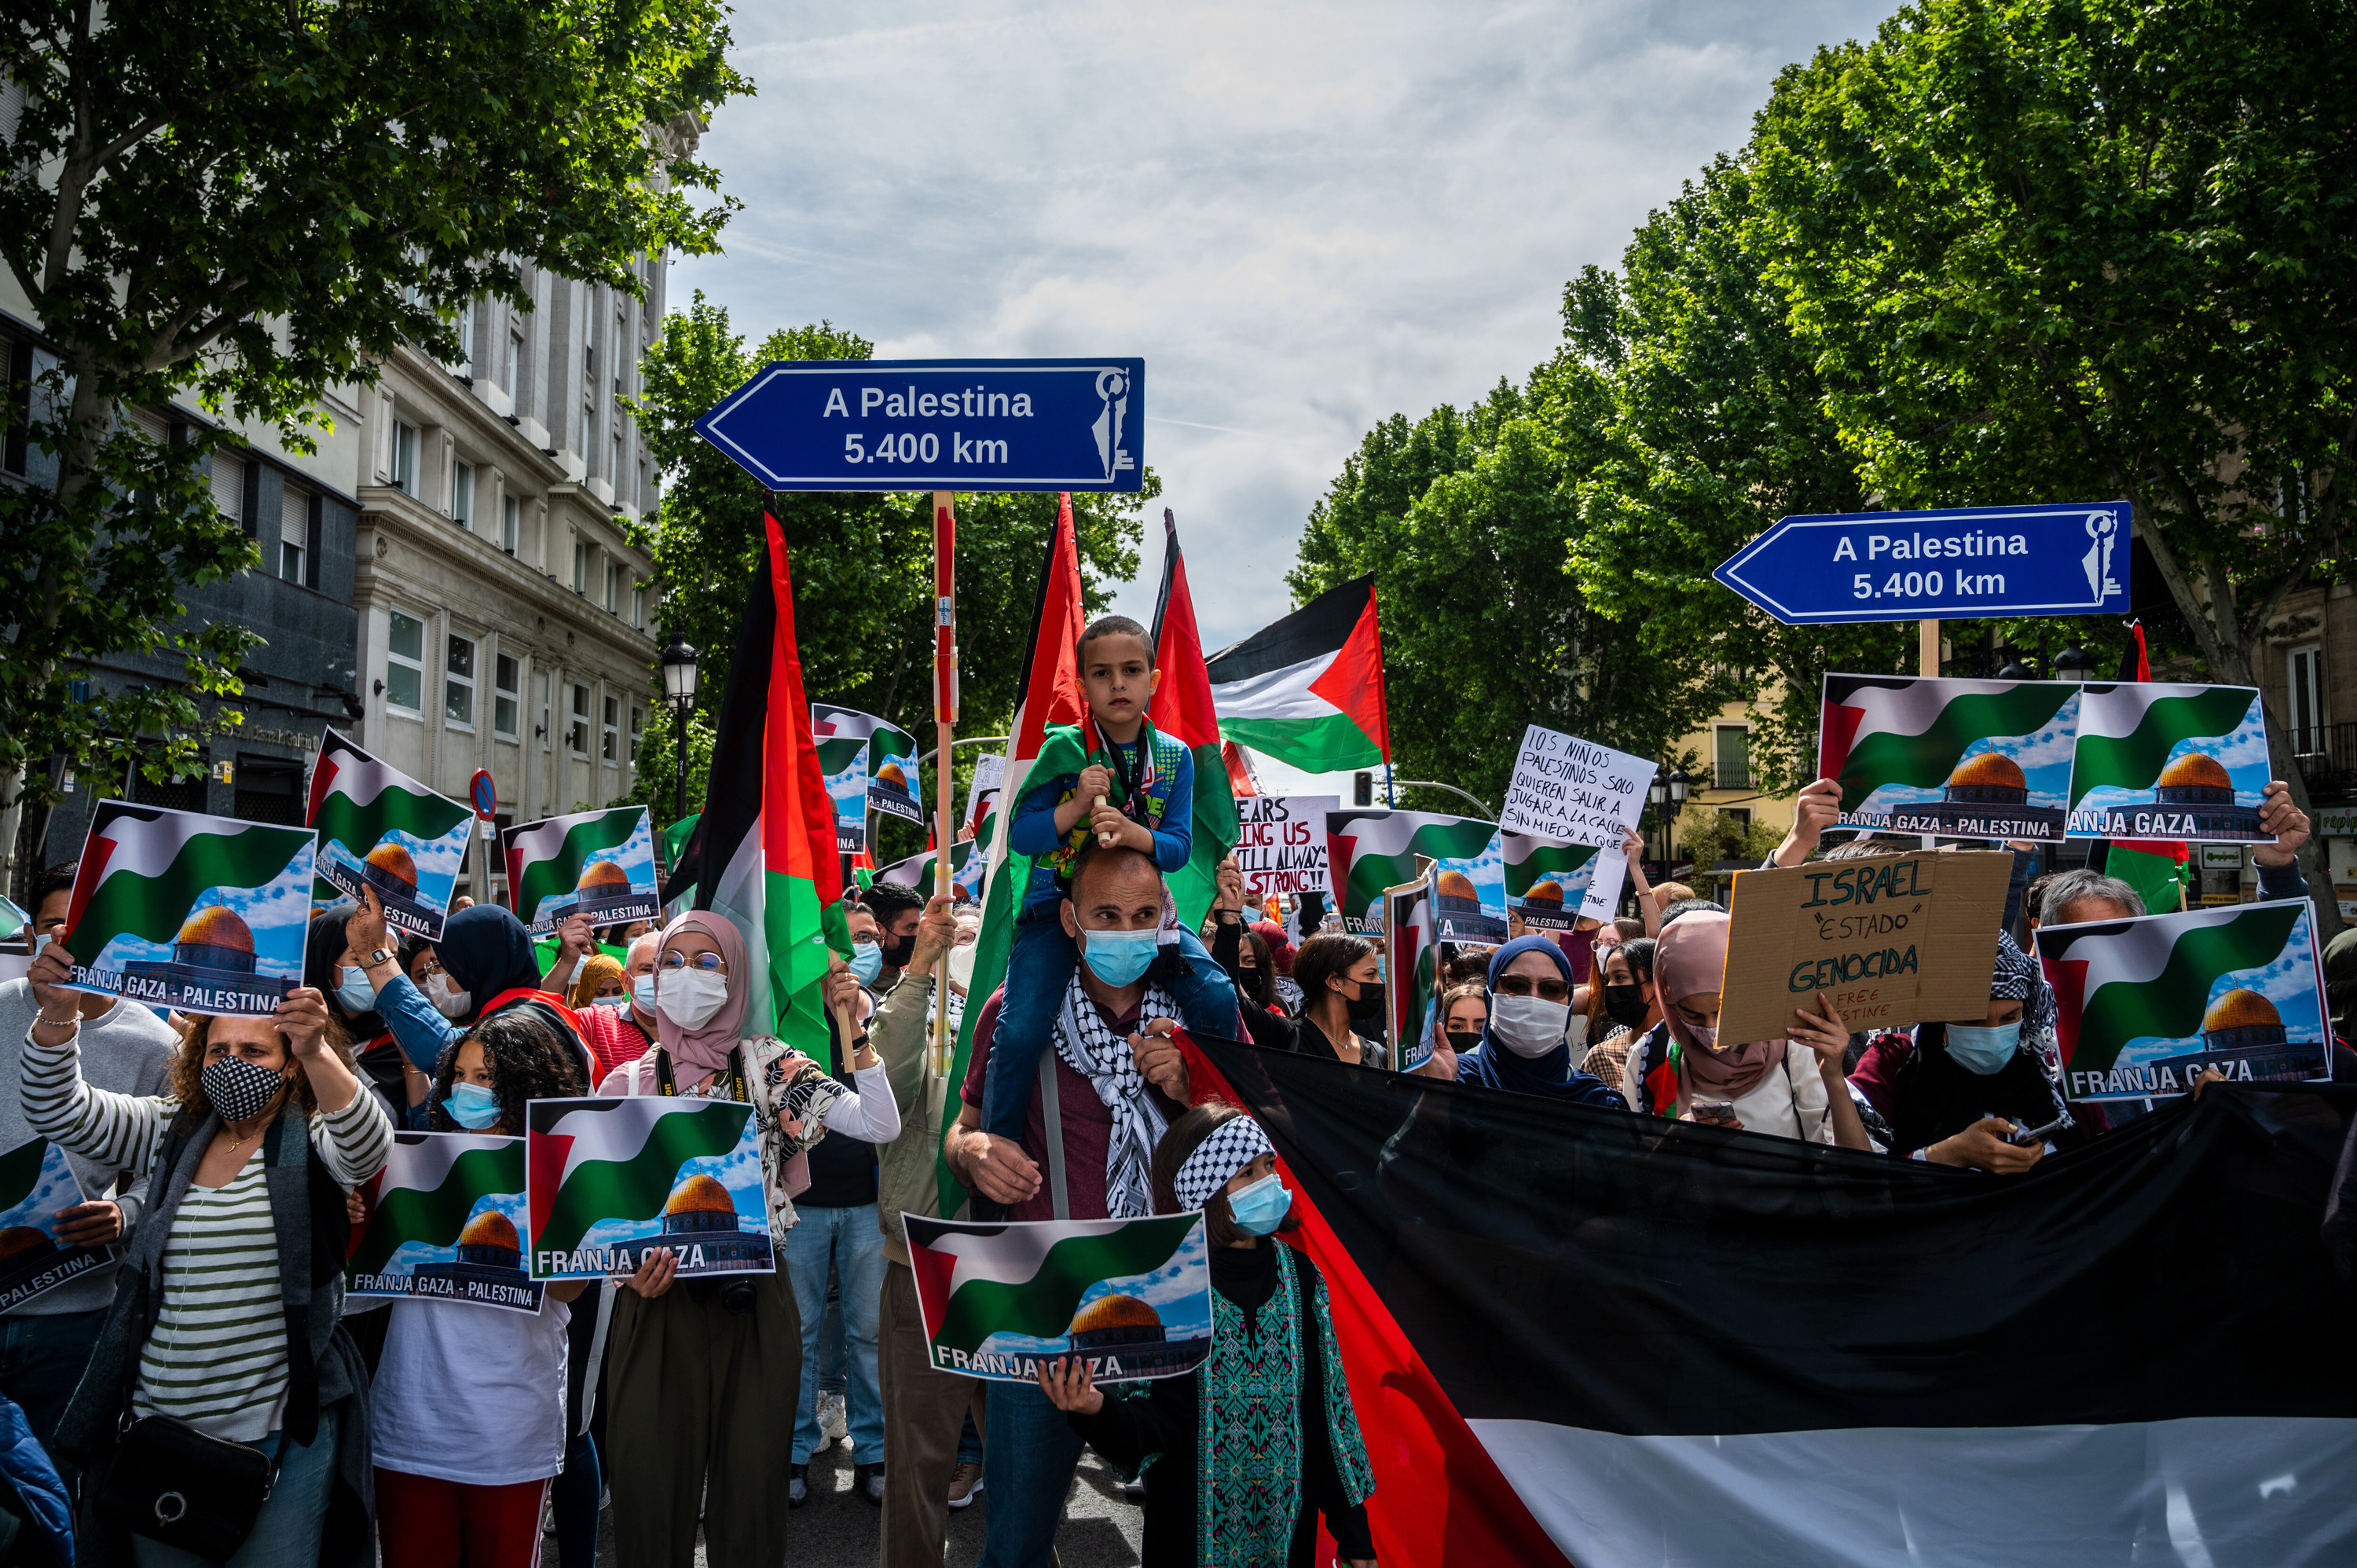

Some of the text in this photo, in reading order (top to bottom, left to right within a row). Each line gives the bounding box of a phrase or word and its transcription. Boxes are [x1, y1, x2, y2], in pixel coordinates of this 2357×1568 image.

[823, 386, 1033, 417] A Palestina
[845, 432, 1008, 463] 5.400 km
[1833, 529, 2028, 562] A Palestina
[1853, 567, 2006, 599] 5.400 km
[1564, 741, 1610, 768] NIÑOS
[1522, 752, 1634, 794] PALESTINOS SOLO
[1510, 788, 1553, 817] JUGAR
[1556, 806, 1567, 821] A
[1571, 809, 1586, 825] LA
[1516, 771, 1620, 815] QUIEREN SALIR A
[882, 798, 919, 820] PALESTINA
[1236, 797, 1289, 822] EARS
[1838, 811, 1891, 828] RANJA
[1897, 816, 1940, 832] GAZA
[1958, 819, 2050, 837] PALESTINA
[2068, 811, 2198, 835] ANJA GAZA
[1237, 821, 1310, 848] ING US
[1505, 808, 1530, 826] SIN
[1533, 818, 1574, 837] MIEDO
[1579, 832, 1589, 843] A
[1595, 834, 1621, 849] QUE
[1276, 845, 1328, 870] ALWAYS
[316, 855, 335, 881] ANJA
[336, 874, 357, 896] GAZA
[369, 898, 430, 933] ESTINA
[1801, 860, 1932, 908] ISRAEL
[1582, 893, 1607, 907] STINE
[526, 921, 555, 935] RANJA
[592, 904, 651, 922] PALESTINA
[1345, 916, 1384, 933] FRAN
[1525, 915, 1568, 929] PALESTINA
[1789, 944, 1917, 992] GENOCIDA
[69, 965, 123, 991] FRANJA
[126, 976, 166, 999] GAZA
[183, 985, 282, 1012] PALESTINA
[1836, 989, 1879, 1006] FREE
[1827, 1005, 1891, 1020] STINE
[2072, 1066, 2179, 1094] FRANJA
[537, 1248, 633, 1273] FRANJA
[0, 1254, 96, 1307] PALESTINA
[354, 1274, 413, 1292] FRANJA
[419, 1277, 454, 1295] GAZA
[468, 1281, 533, 1306] PALESTINA
[937, 1345, 1039, 1377] FRANJA
